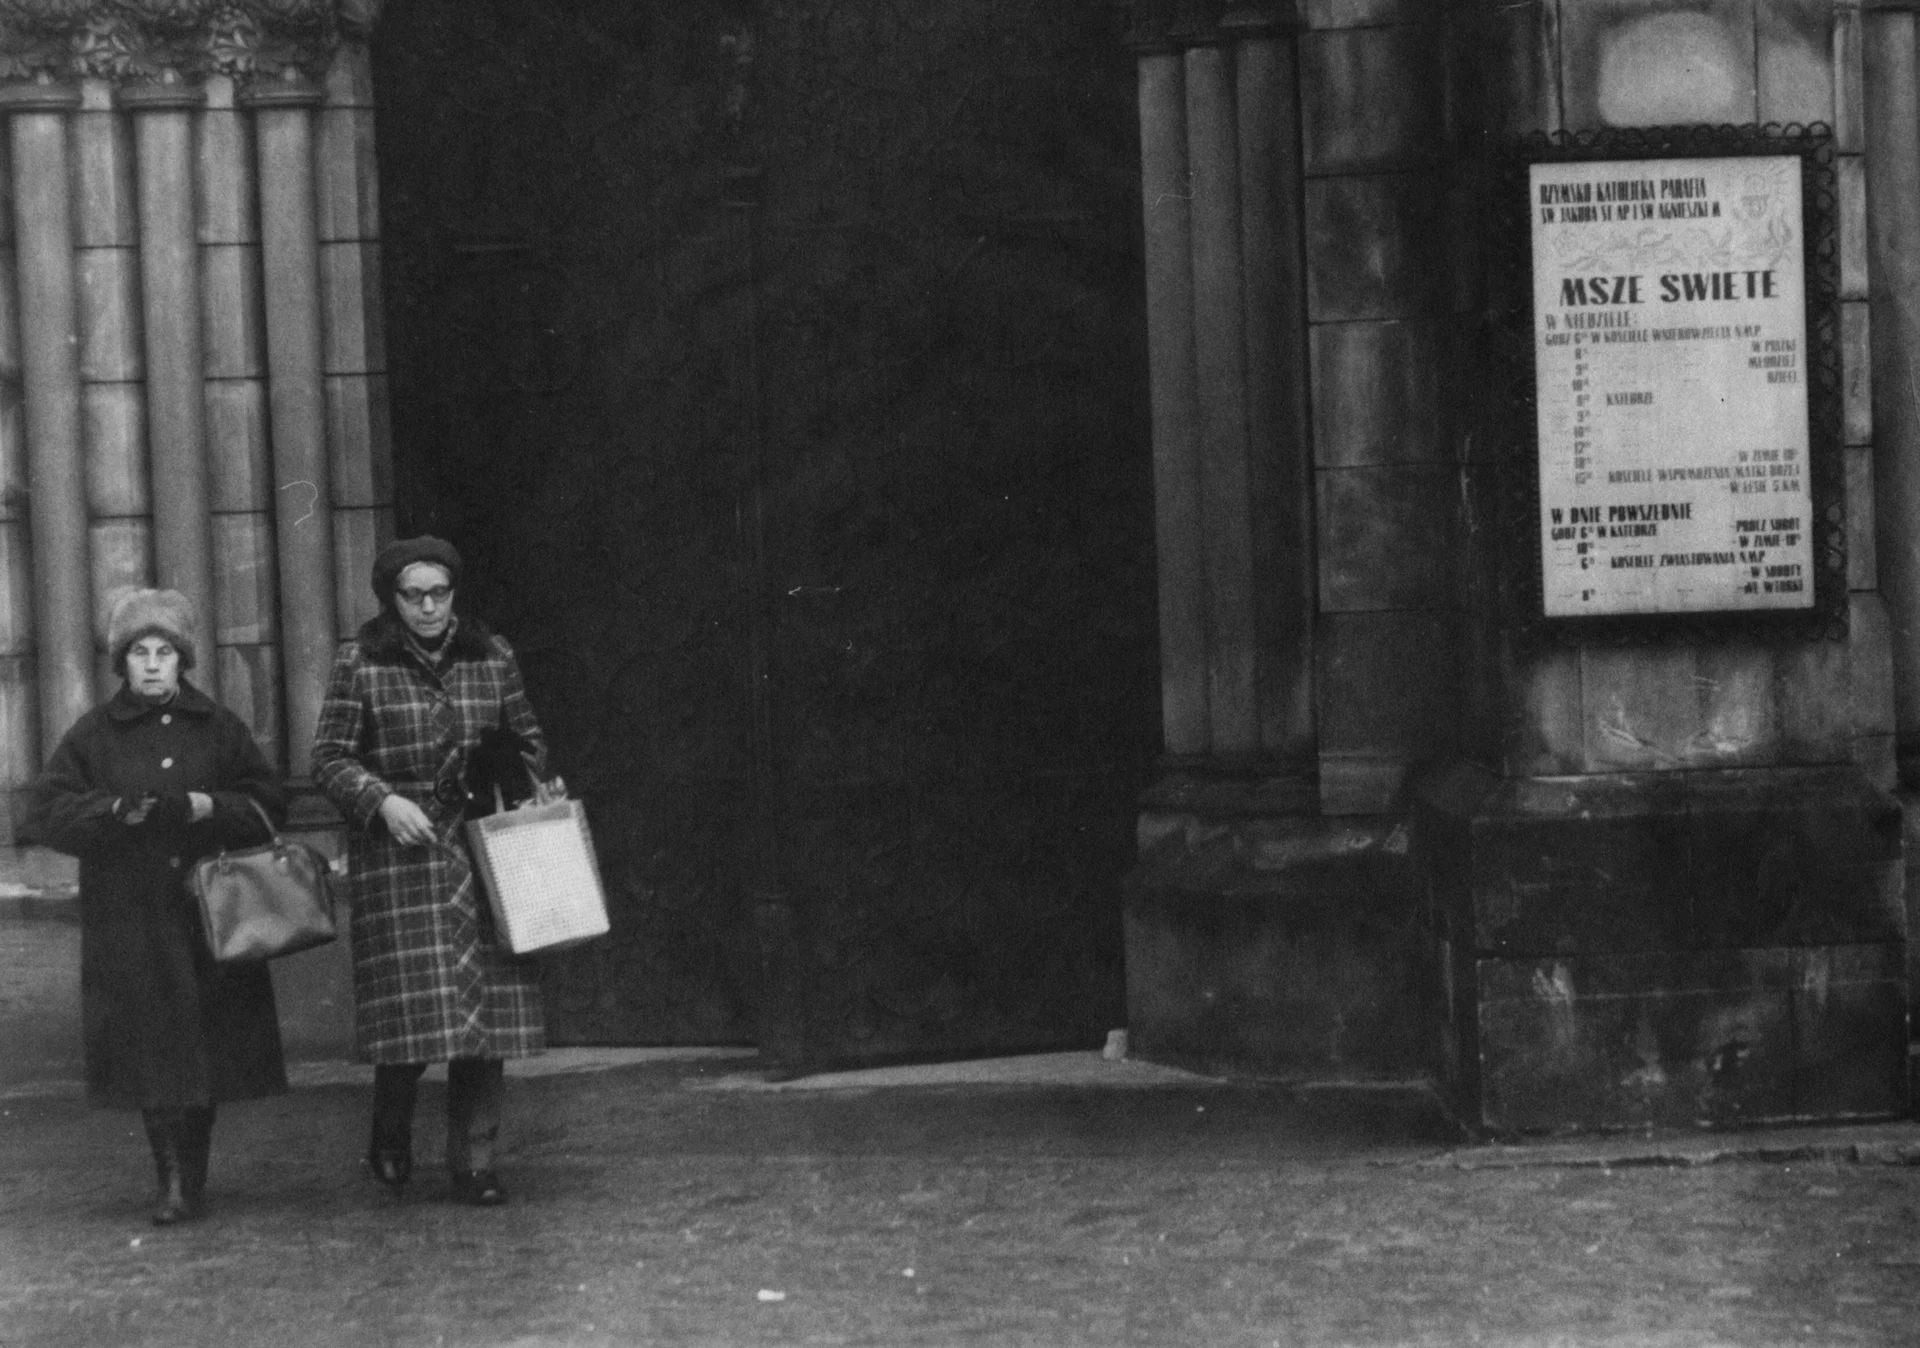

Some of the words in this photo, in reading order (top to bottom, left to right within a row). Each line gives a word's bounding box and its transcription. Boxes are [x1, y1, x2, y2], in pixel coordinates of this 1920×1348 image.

[1560, 276, 1645, 306] MSZE
[1551, 508, 1563, 524] W
[1571, 506, 1601, 524] DNIE
[1609, 503, 1691, 522] POWSZEDNIE
